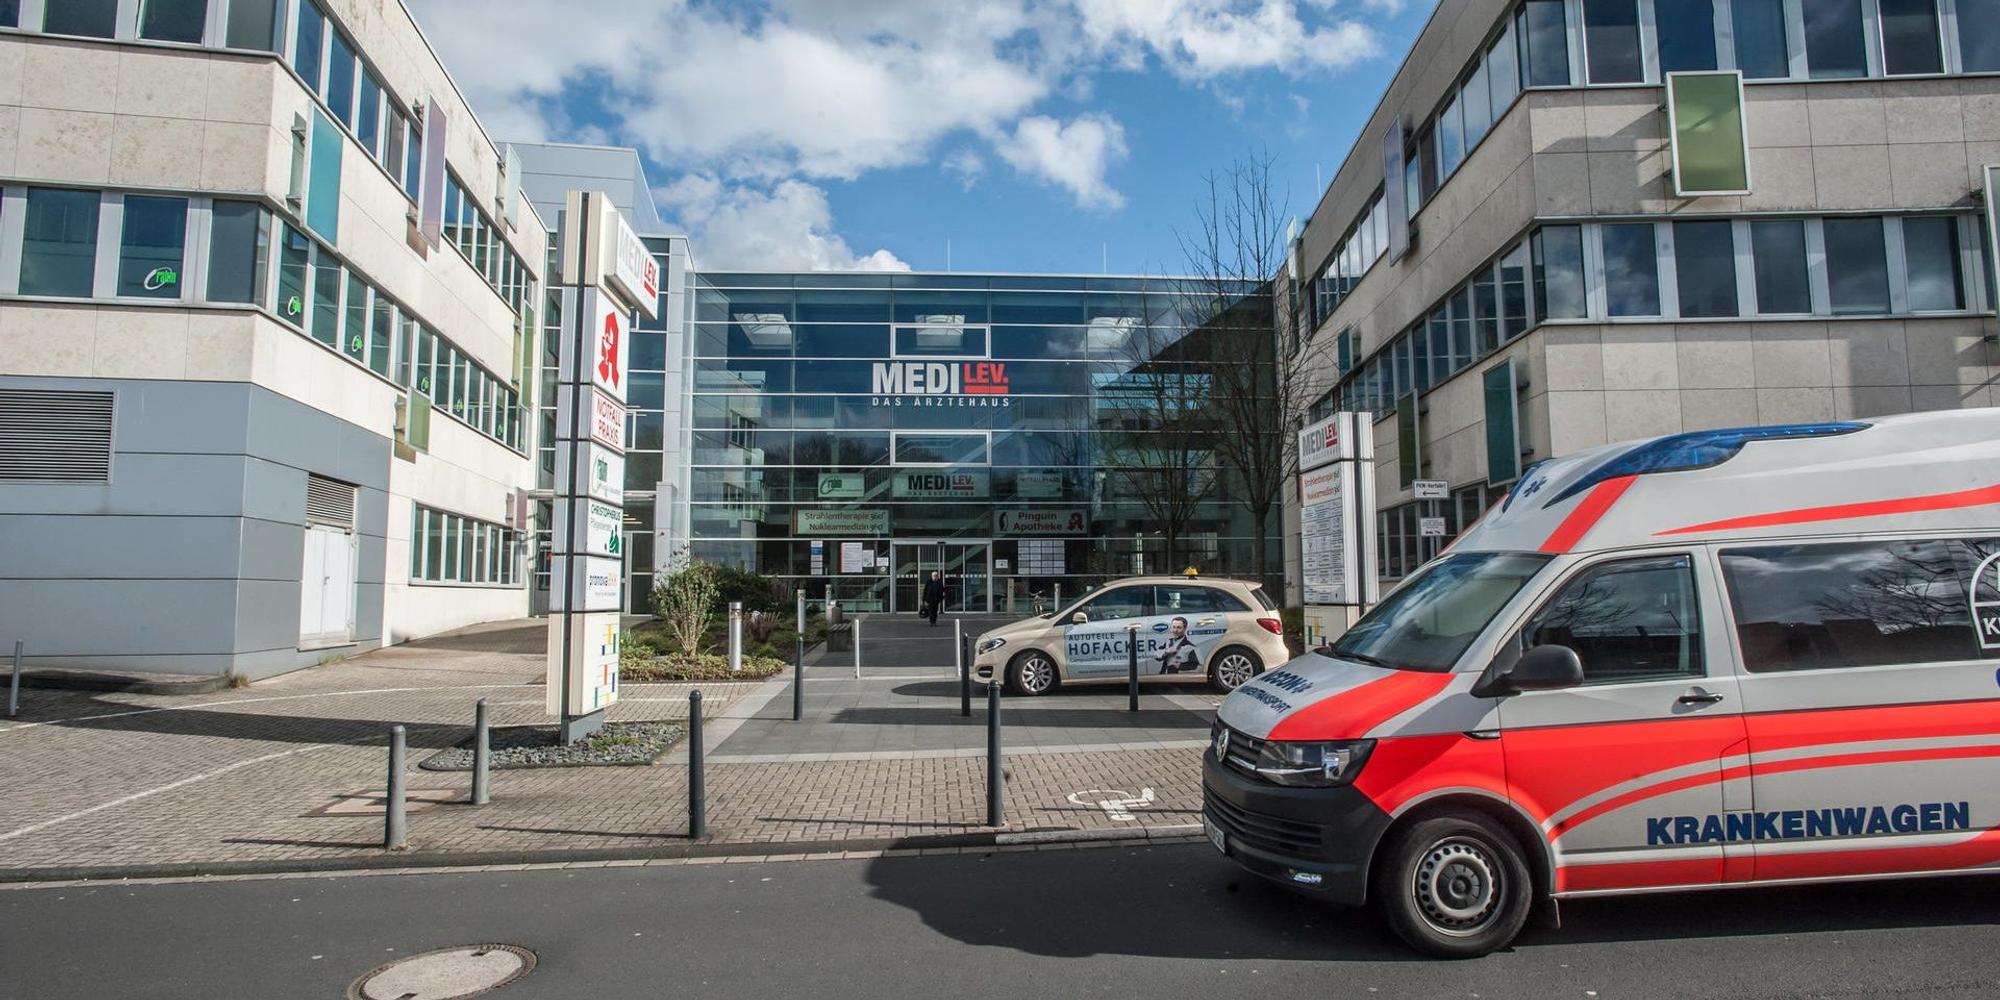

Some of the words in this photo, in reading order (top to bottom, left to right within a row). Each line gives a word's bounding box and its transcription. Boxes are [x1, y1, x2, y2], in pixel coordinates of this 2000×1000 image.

[872, 362, 960, 394] MEDI
[963, 362, 1009, 383] LEV.
[872, 397, 902, 407] DAS
[597, 398, 621, 427] NOTFALL
[598, 419, 619, 444] PRAXIS
[1302, 427, 1325, 456] MEDI
[908, 475, 951, 490] MEDI
[804, 511, 870, 521] Strahlentherapie
[1018, 511, 1058, 522] Pinguin
[809, 523, 868, 531] Nuklearmedizin
[1013, 522, 1063, 533] Apotheke
[1068, 633, 1115, 641] AUTOTEILE
[1068, 639, 1157, 656] HOFACKER
[1646, 801, 1970, 846] KRANKENWAGEN
